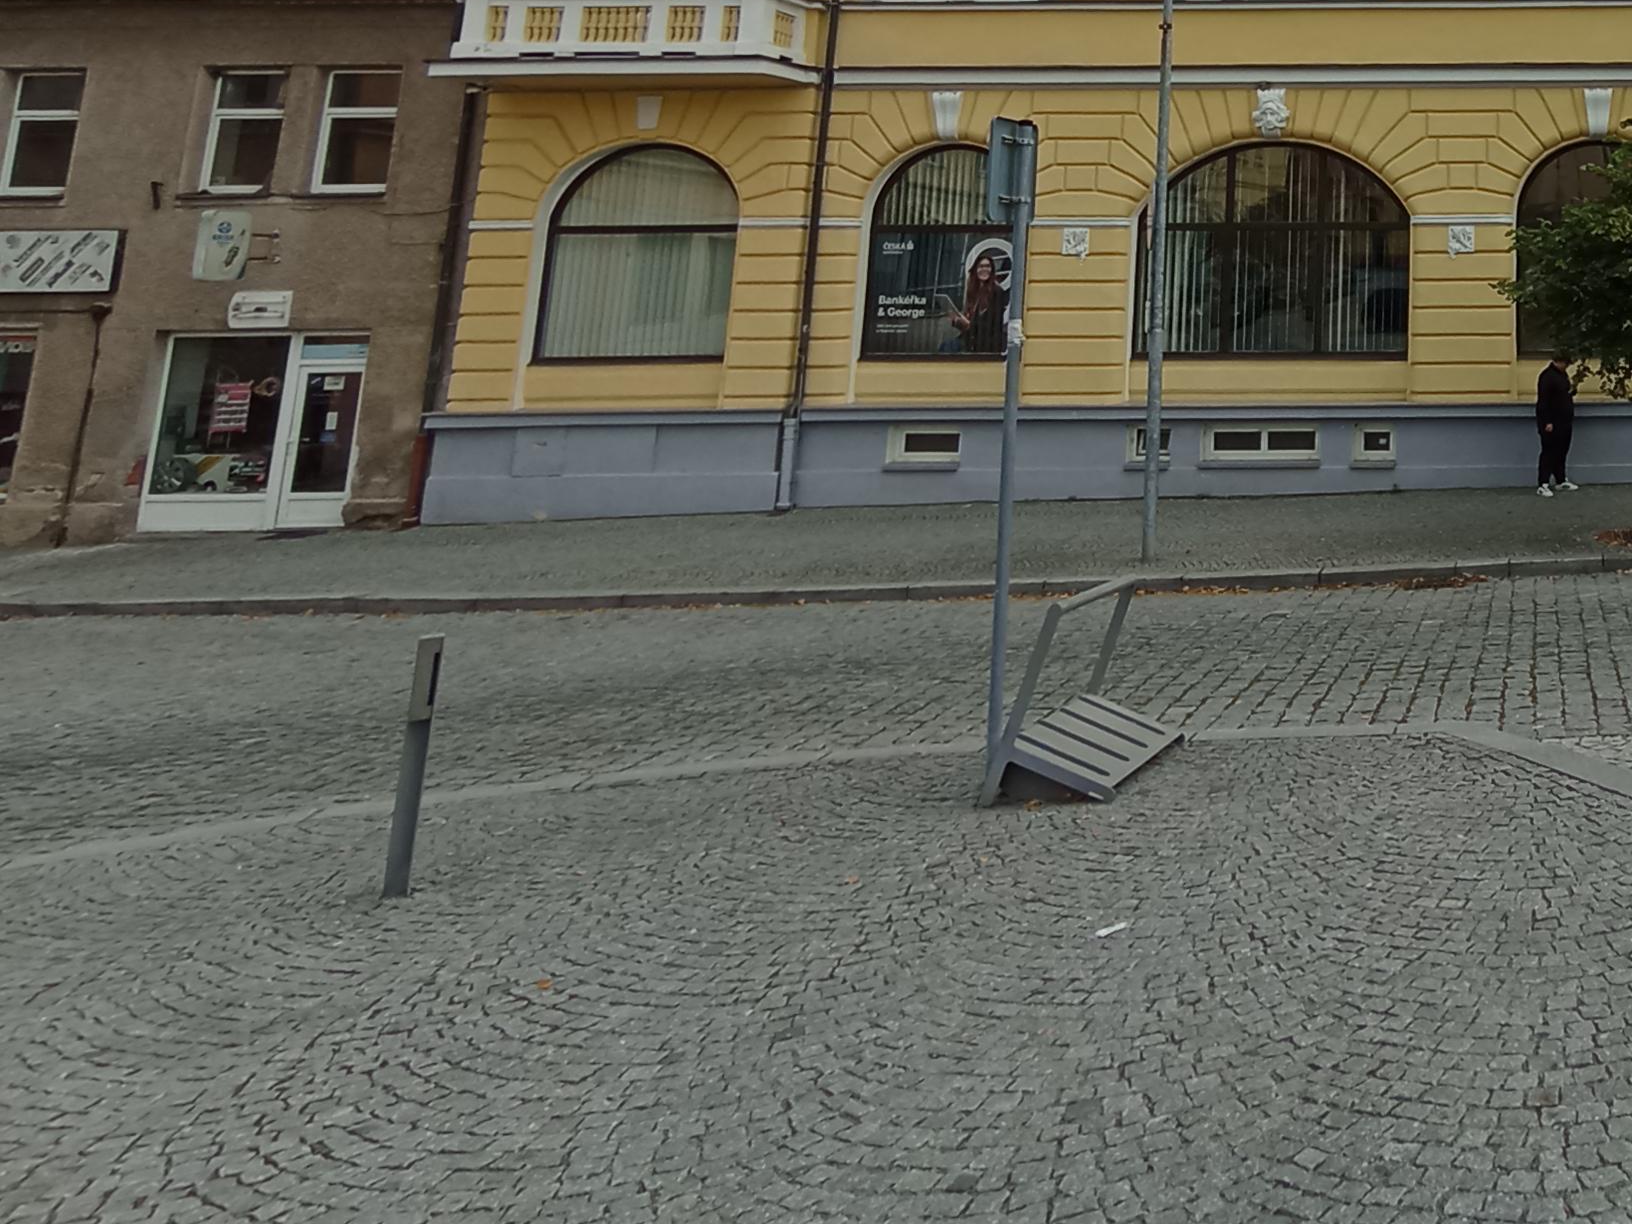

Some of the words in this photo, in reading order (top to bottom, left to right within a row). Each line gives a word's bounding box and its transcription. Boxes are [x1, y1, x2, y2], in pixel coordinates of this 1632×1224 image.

[878, 294, 926, 305] Bankéřka
[877, 307, 886, 317] &
[887, 307, 925, 318] George
